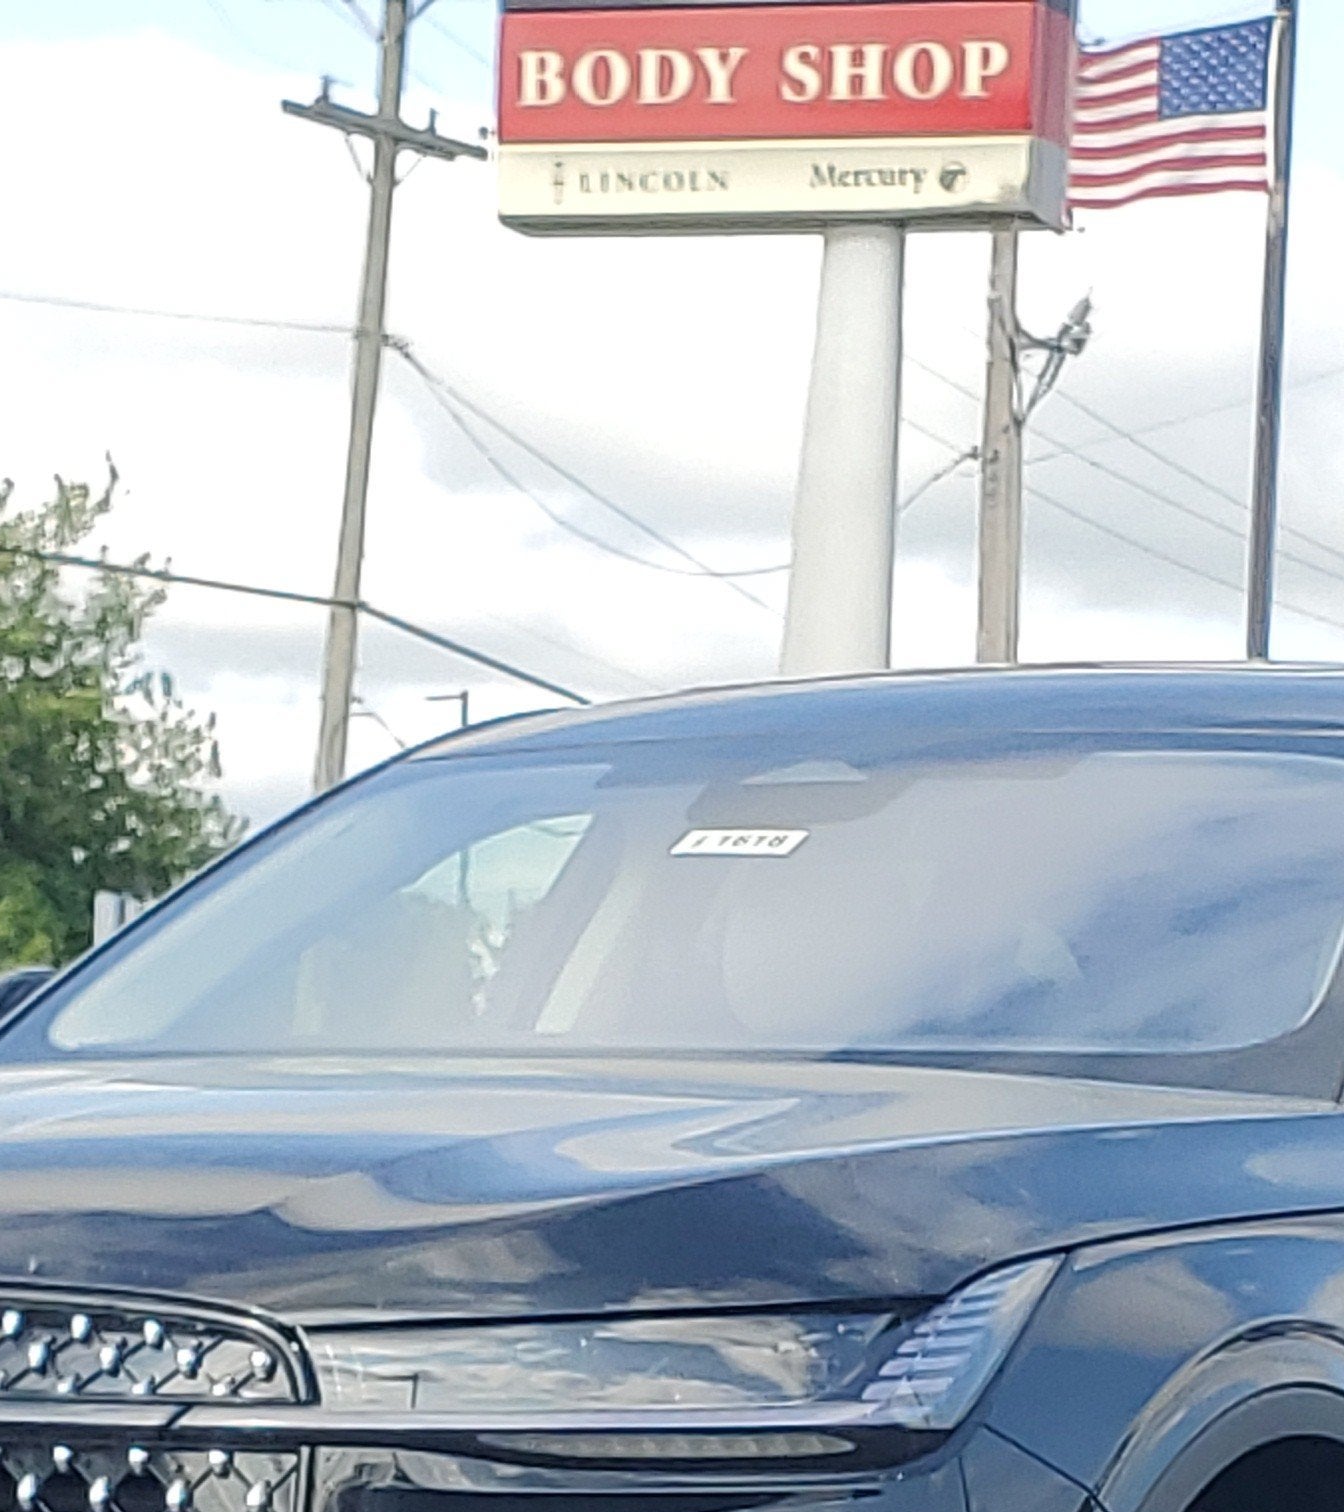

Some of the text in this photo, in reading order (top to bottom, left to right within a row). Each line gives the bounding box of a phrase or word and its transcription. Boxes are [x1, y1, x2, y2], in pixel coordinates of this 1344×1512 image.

[519, 41, 1009, 106] BODY SHOP
[578, 169, 730, 194] LINCOLN
[809, 163, 928, 193] Mercury
